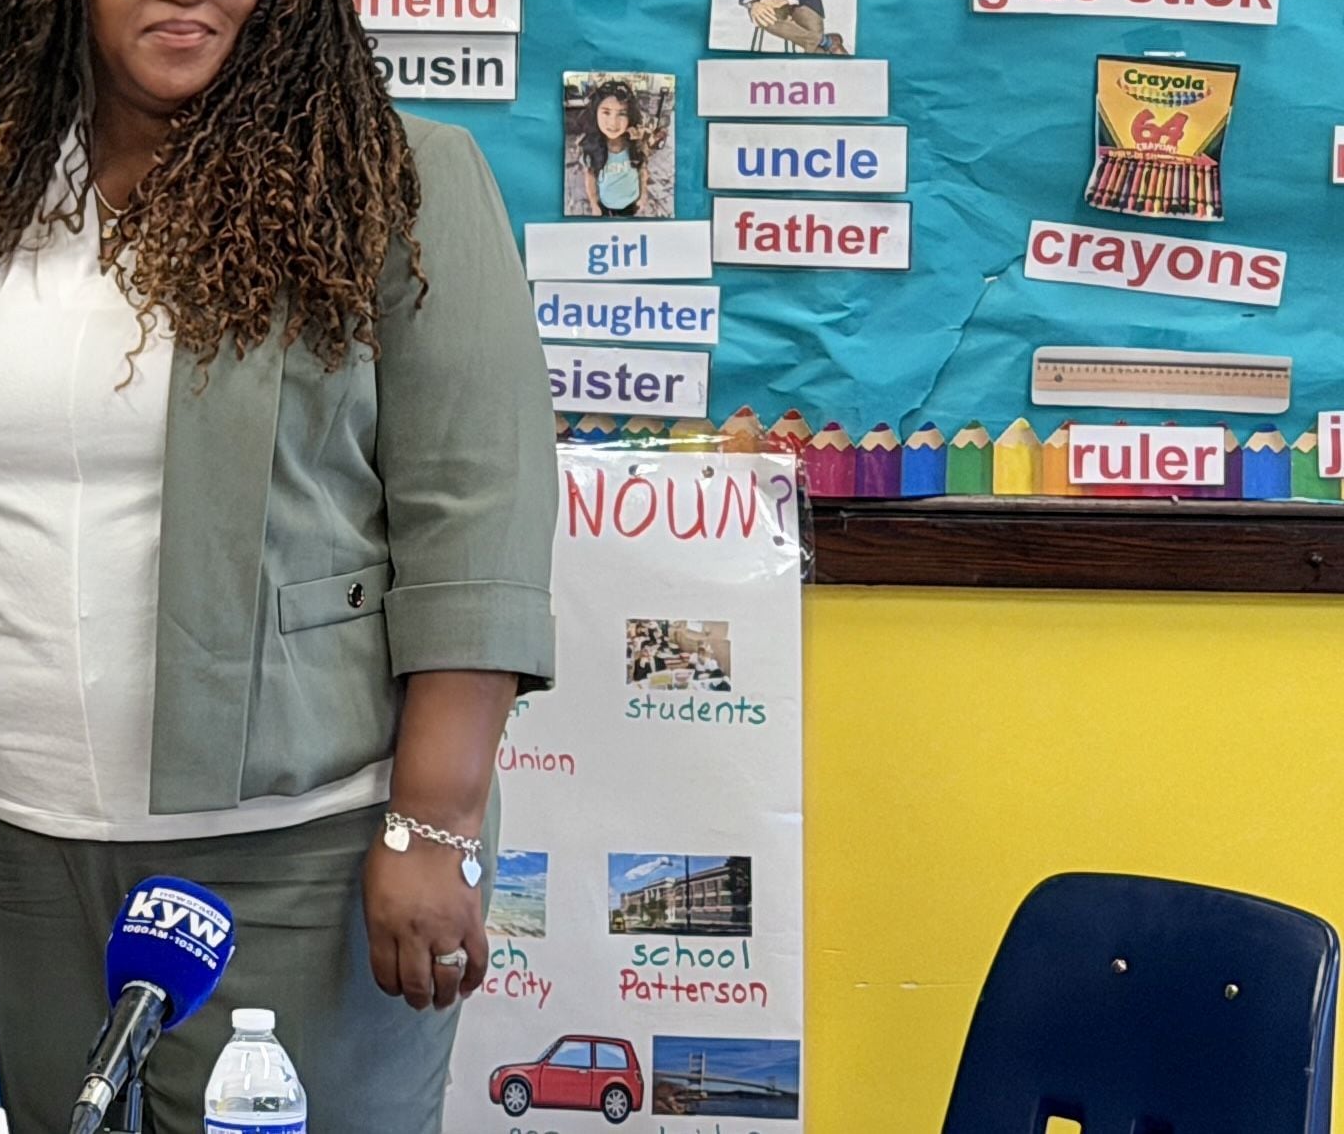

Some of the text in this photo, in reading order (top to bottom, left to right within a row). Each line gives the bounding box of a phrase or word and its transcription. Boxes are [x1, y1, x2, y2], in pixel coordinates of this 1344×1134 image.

[749, 76, 835, 105] man
[1124, 69, 1204, 90] Crayola
[1131, 109, 1189, 146] 64
[736, 138, 879, 179] uncle
[735, 211, 888, 255] father
[587, 234, 648, 275] girl
[1031, 229, 1280, 292] crayons
[537, 294, 715, 335] daughter
[548, 360, 684, 403] sister
[1070, 433, 1216, 481] ruler
[566, 469, 794, 547] NOUN?
[625, 695, 767, 725] students
[498, 746, 575, 775] Union
[631, 939, 750, 969] school
[505, 970, 552, 1008] City
[619, 968, 768, 1007] Patterson
